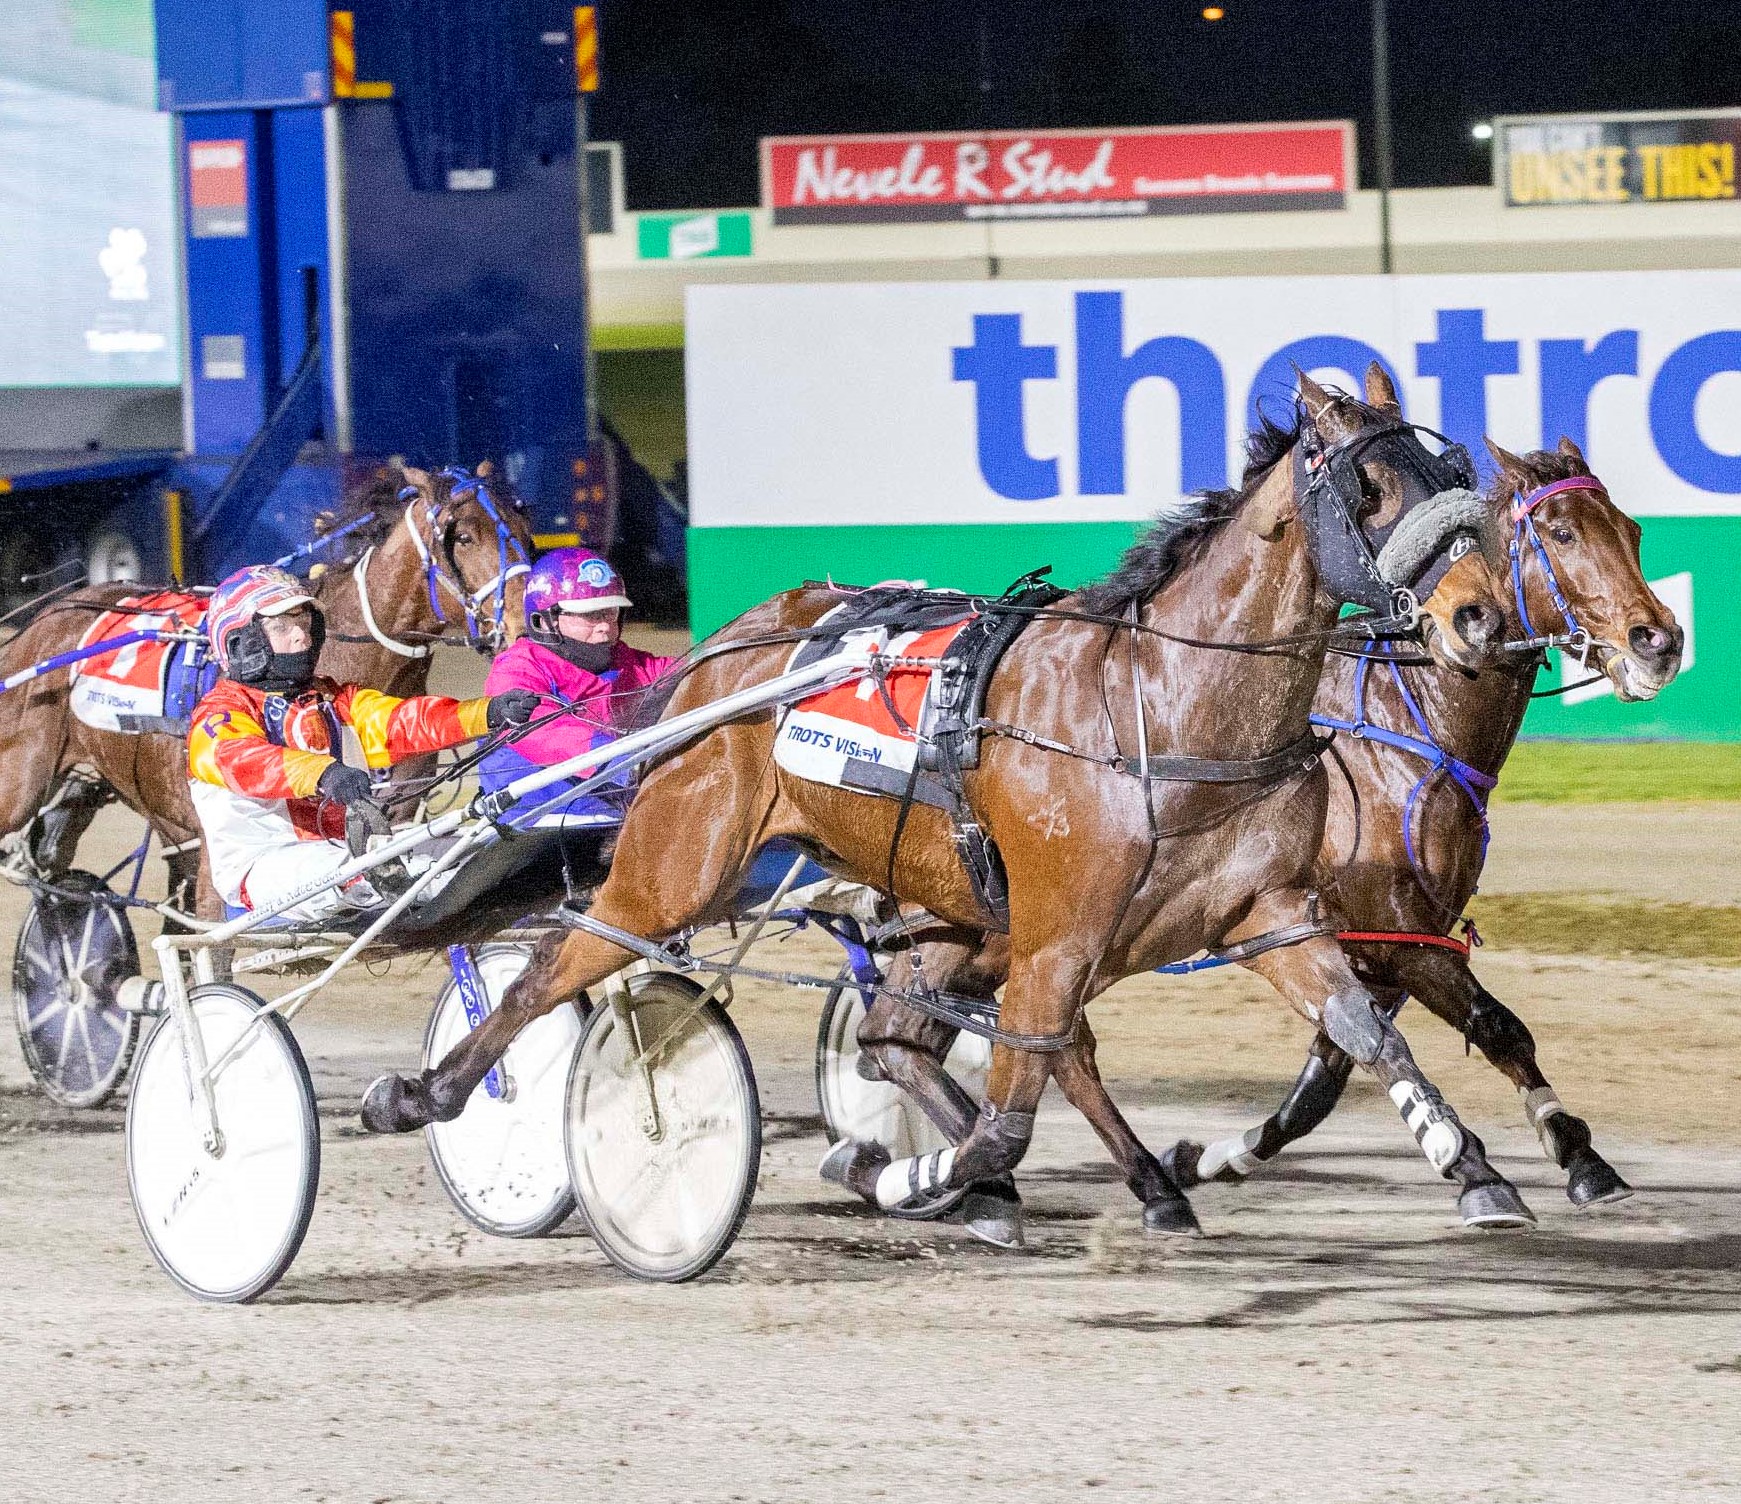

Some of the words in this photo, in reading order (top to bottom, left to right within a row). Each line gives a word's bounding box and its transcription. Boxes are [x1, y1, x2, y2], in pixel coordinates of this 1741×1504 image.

[794, 143, 945, 202] Nevele
[955, 143, 992, 197] R
[1002, 140, 1115, 199] Stud
[787, 725, 834, 748] TROTS
